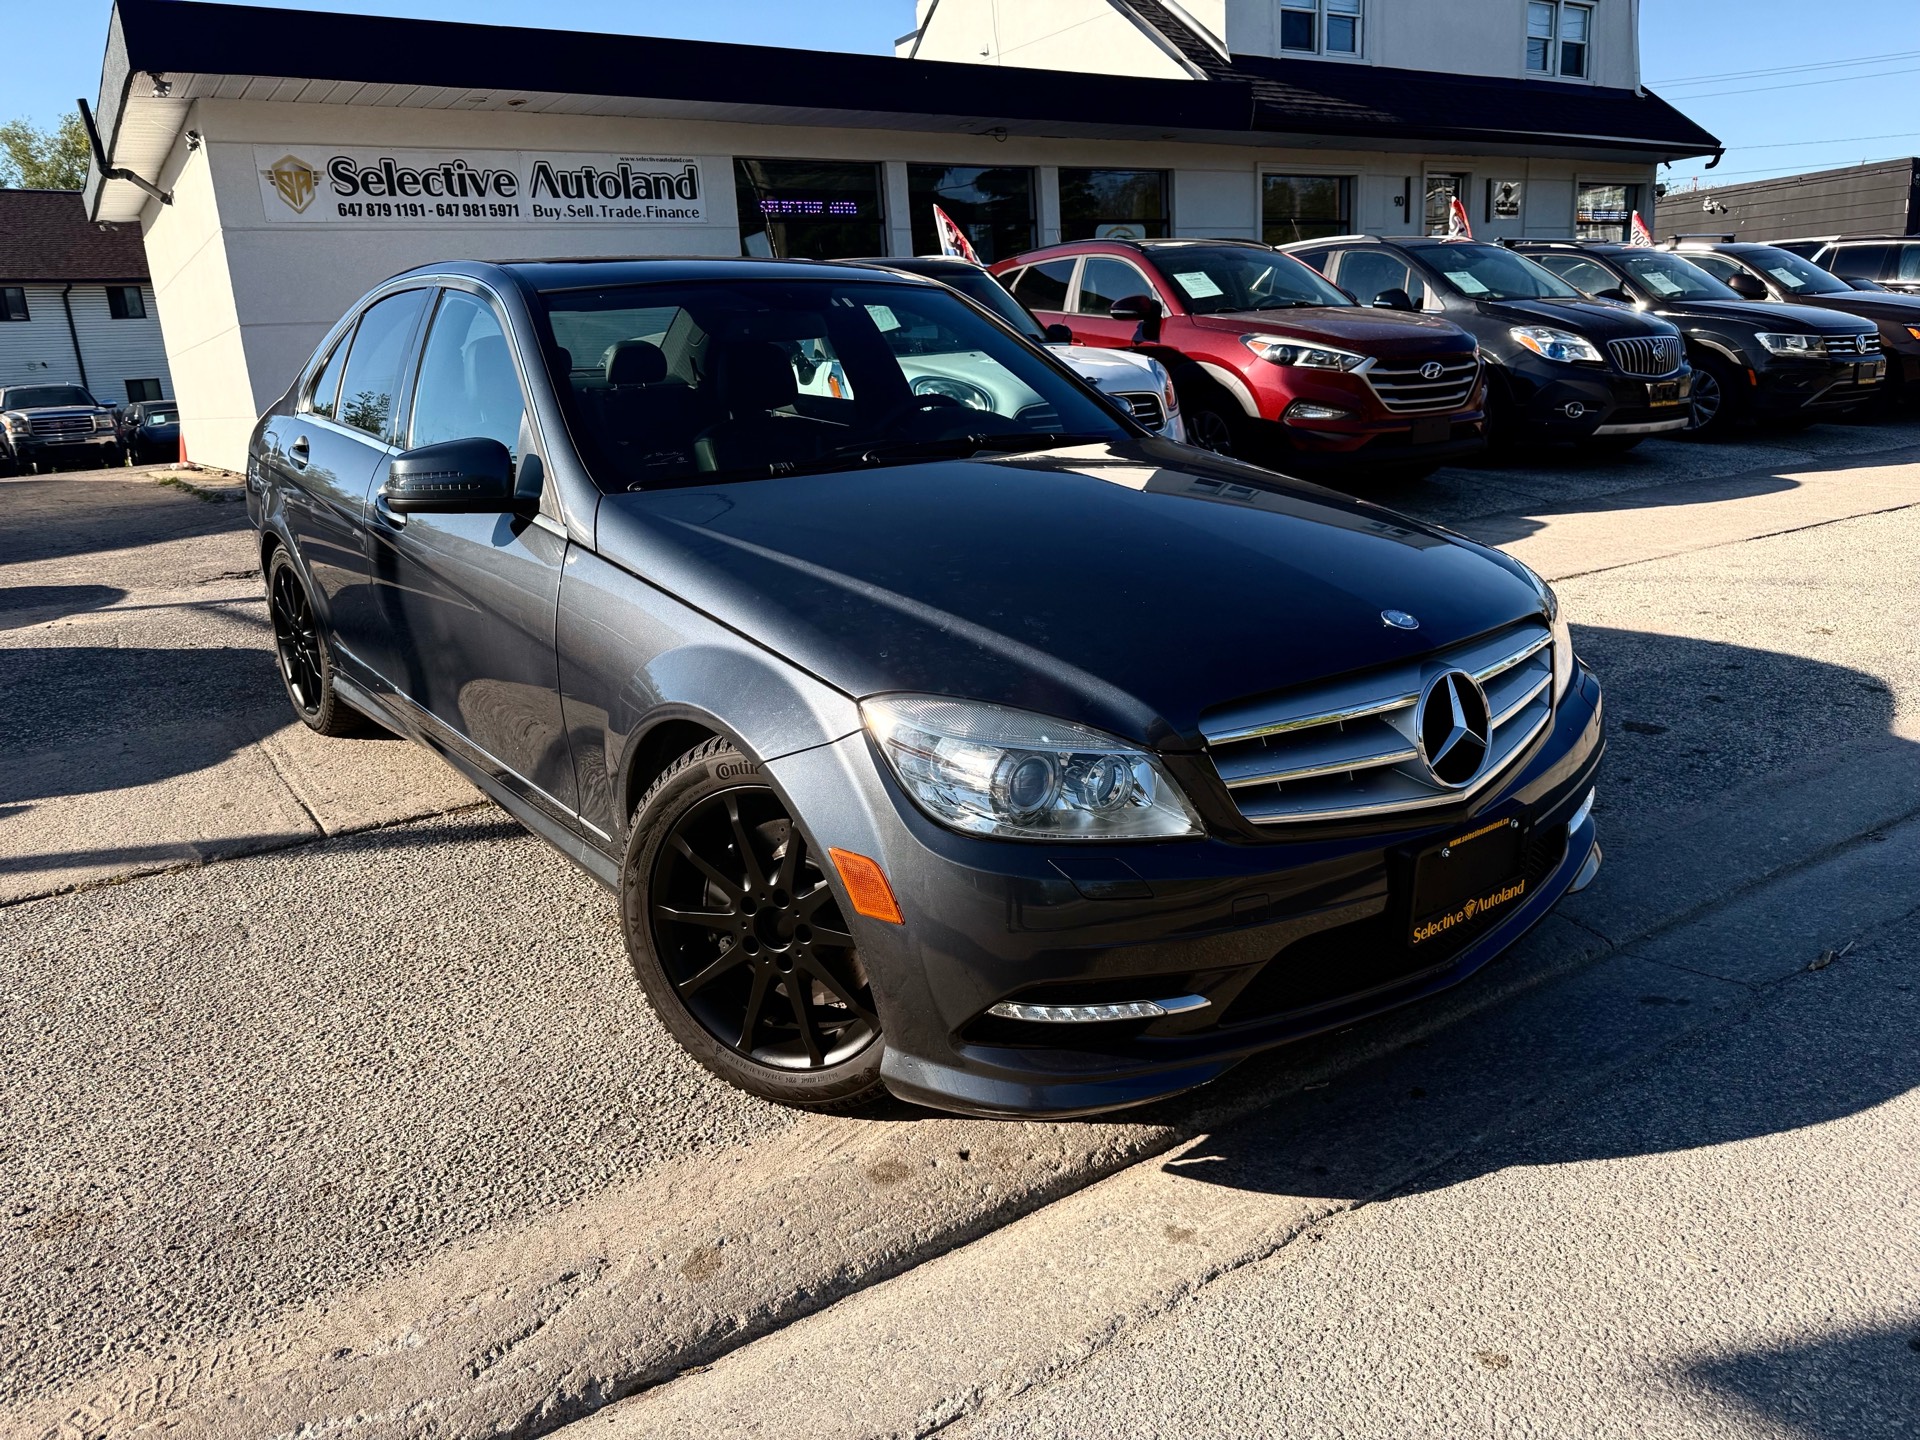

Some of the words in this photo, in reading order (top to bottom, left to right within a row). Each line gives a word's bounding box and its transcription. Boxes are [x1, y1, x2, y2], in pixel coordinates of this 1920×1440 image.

[327, 156, 519, 198] Selective
[530, 161, 700, 201] Autoland
[338, 203, 363, 217] 647
[366, 203, 392, 217] 879
[394, 203, 425, 217] 1191
[436, 203, 459, 217] 647
[462, 204, 487, 217] 981
[489, 203, 520, 218] 5971
[1393, 195, 1405, 207] 90
[1412, 912, 1463, 943] Selective
[1475, 880, 1525, 914] Autoland
